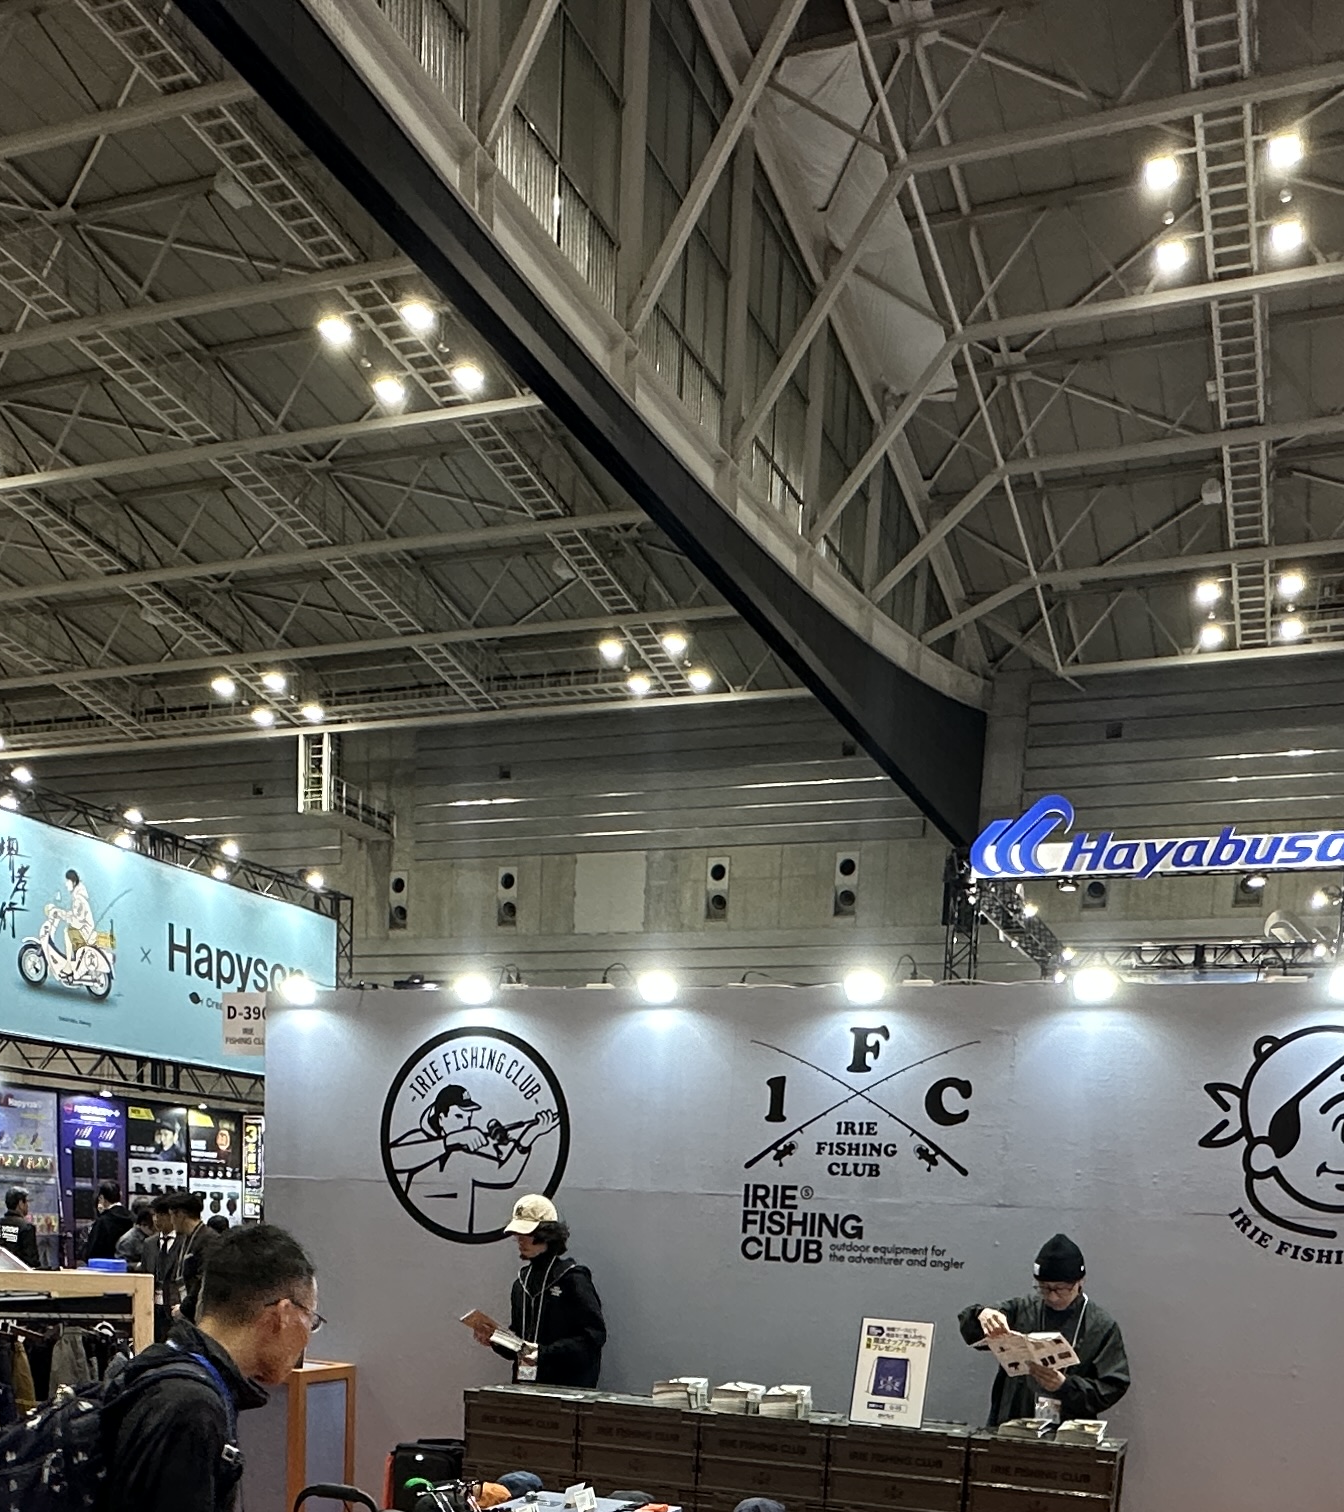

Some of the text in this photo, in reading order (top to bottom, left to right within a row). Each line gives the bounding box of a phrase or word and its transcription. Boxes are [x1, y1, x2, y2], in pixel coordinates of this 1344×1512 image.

[442, 1047, 507, 1075] FISHING
[846, 1025, 890, 1073] F
[924, 1077, 972, 1126] C
[836, 1121, 878, 1136] IRIE
[816, 1141, 898, 1157] FISHING
[827, 1163, 881, 1177] CLUB
[743, 1183, 798, 1210] IRIE
[741, 1210, 864, 1240] FISHING
[1228, 1207, 1273, 1249] IRIE
[741, 1236, 823, 1264] CLUB
[829, 1242, 946, 1257] outdoor equipment for
[829, 1253, 964, 1271] the adventurer and angler
